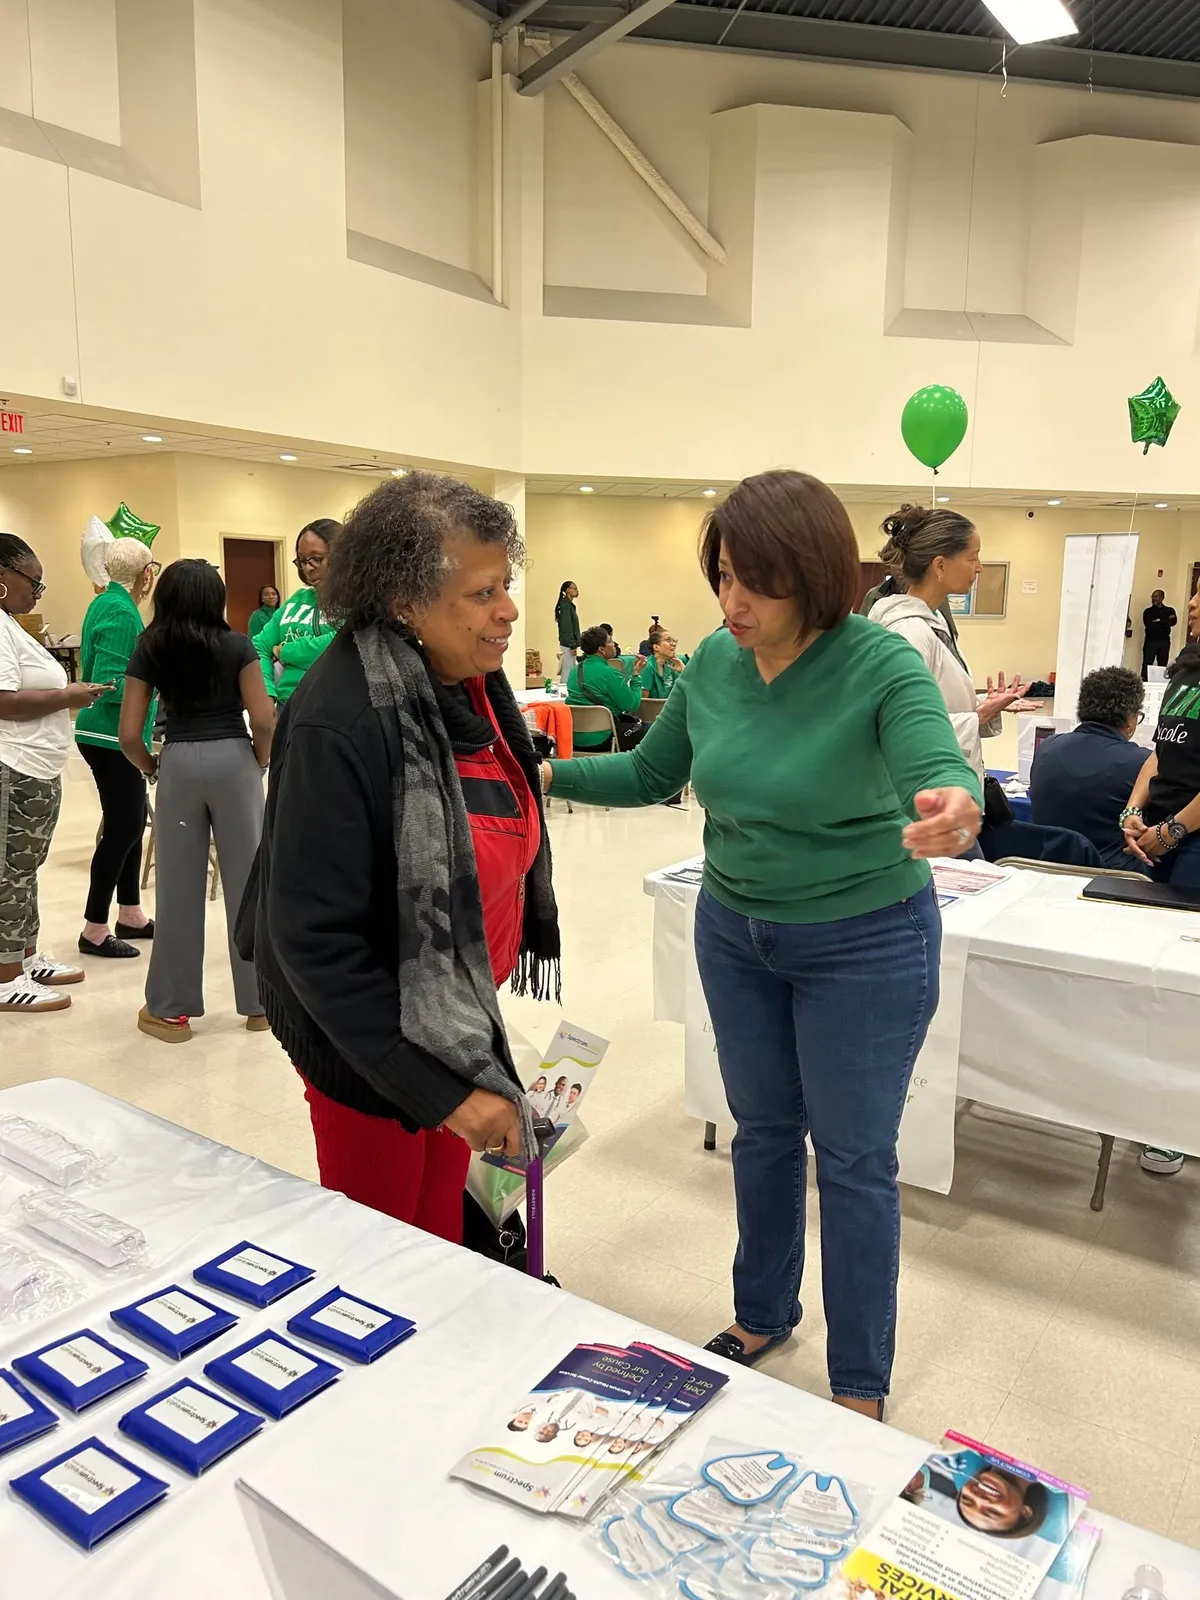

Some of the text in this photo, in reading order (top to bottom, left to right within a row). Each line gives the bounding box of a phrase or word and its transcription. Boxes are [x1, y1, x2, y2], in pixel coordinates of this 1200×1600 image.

[1, 412, 23, 433] EXIT
[591, 1361, 605, 1369] by
[601, 1355, 649, 1374] our Cause
[603, 1364, 643, 1382] Defined
[608, 1384, 631, 1395] Spectrum
[695, 1380, 713, 1388] our
[989, 1456, 1030, 1478] CONTACT US
[879, 1532, 897, 1545] Care
